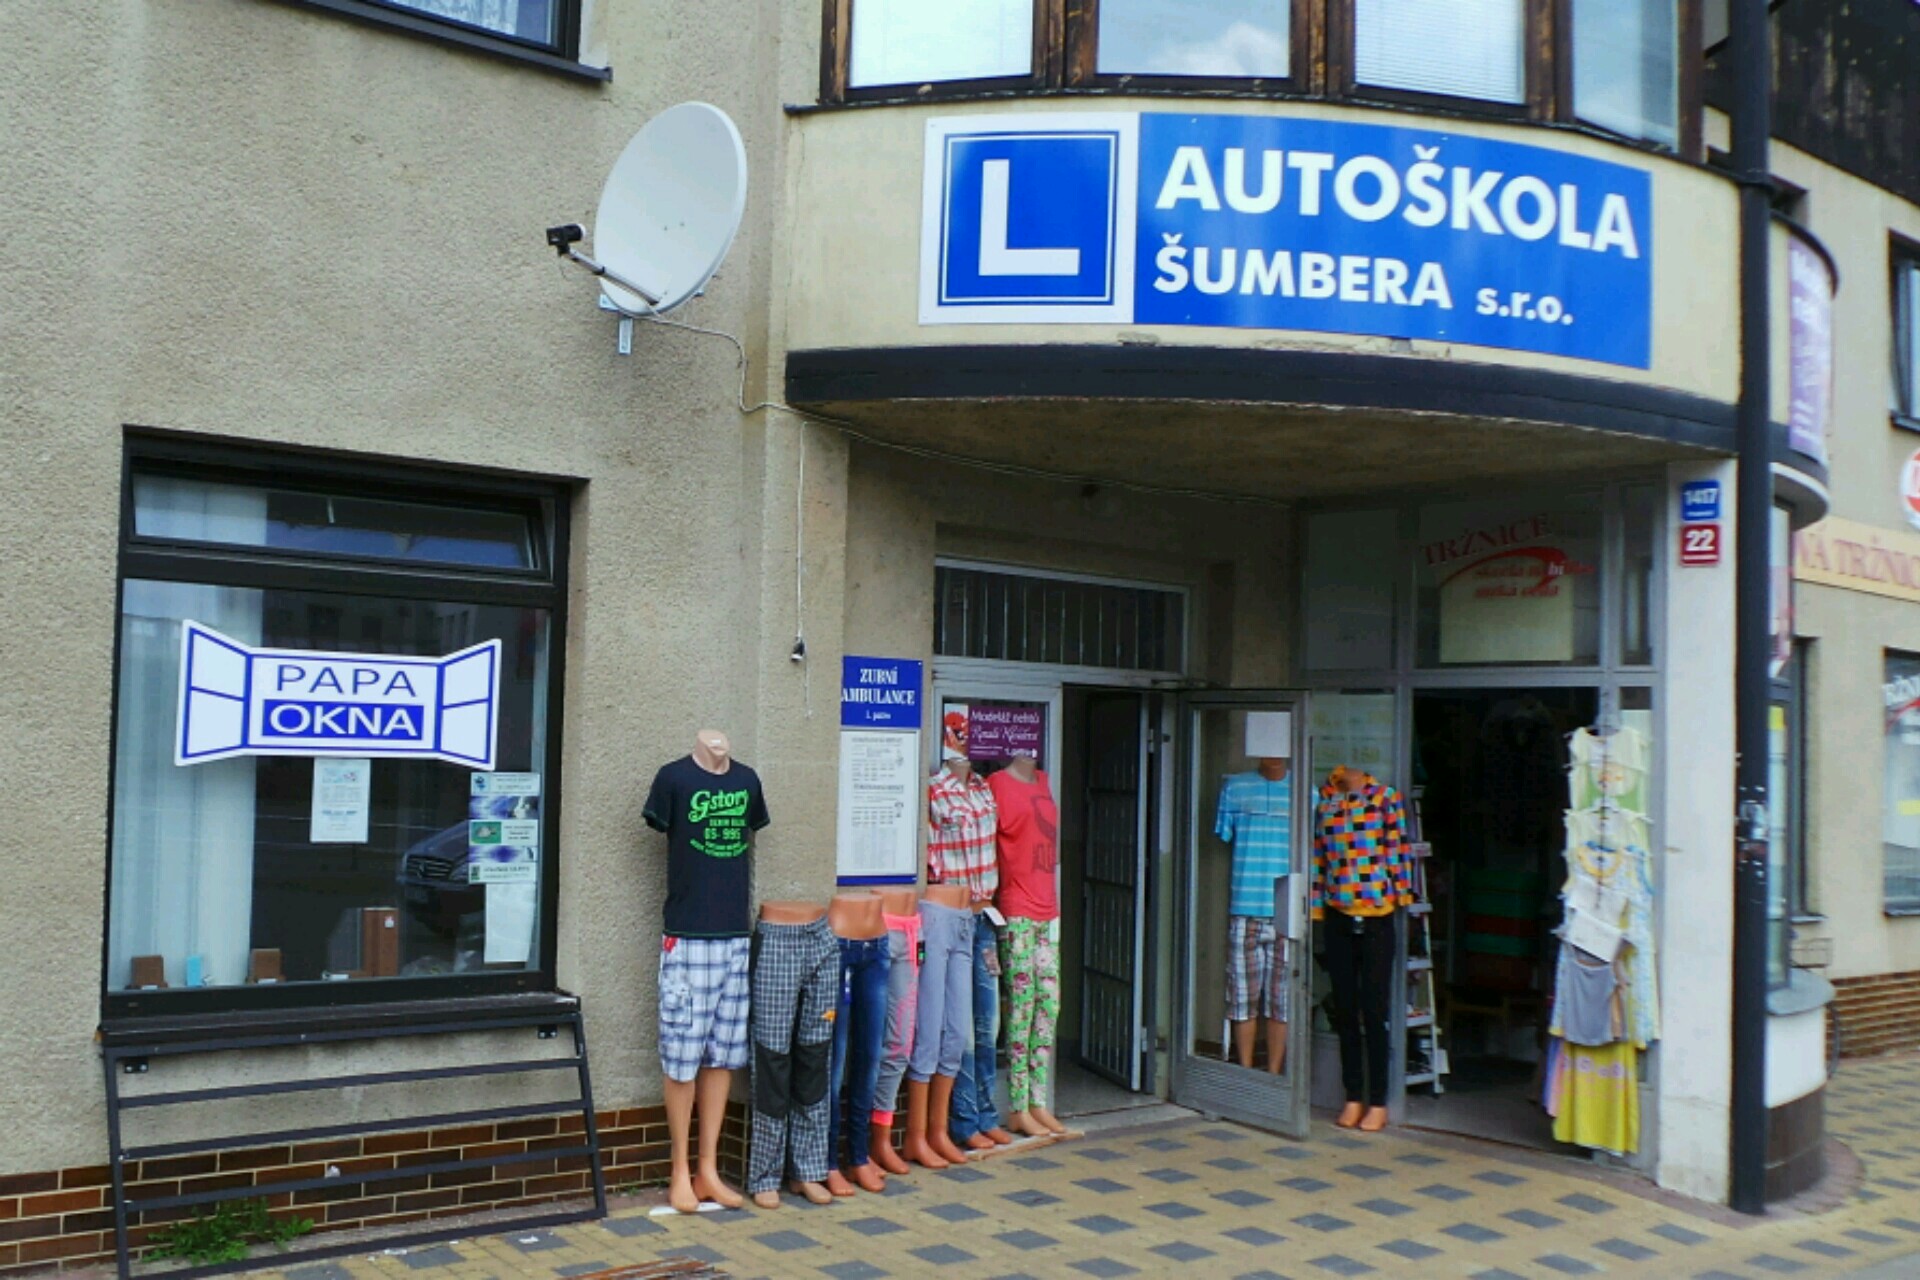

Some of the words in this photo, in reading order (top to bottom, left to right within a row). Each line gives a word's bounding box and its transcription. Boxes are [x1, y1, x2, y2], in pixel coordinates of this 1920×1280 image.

[978, 158, 1081, 277] L
[1155, 144, 1640, 259] AUTOŠKOLA
[1153, 233, 1452, 310] ŠUMBERA
[1476, 286, 1574, 326] s.r.o.
[1422, 512, 1552, 567] TRŽNICE
[1685, 529, 1716, 552] 22
[276, 664, 417, 698] PAPA
[860, 666, 898, 685] ZUBNÍ
[841, 687, 915, 706] AMBULANCE
[269, 703, 418, 737] OKNA
